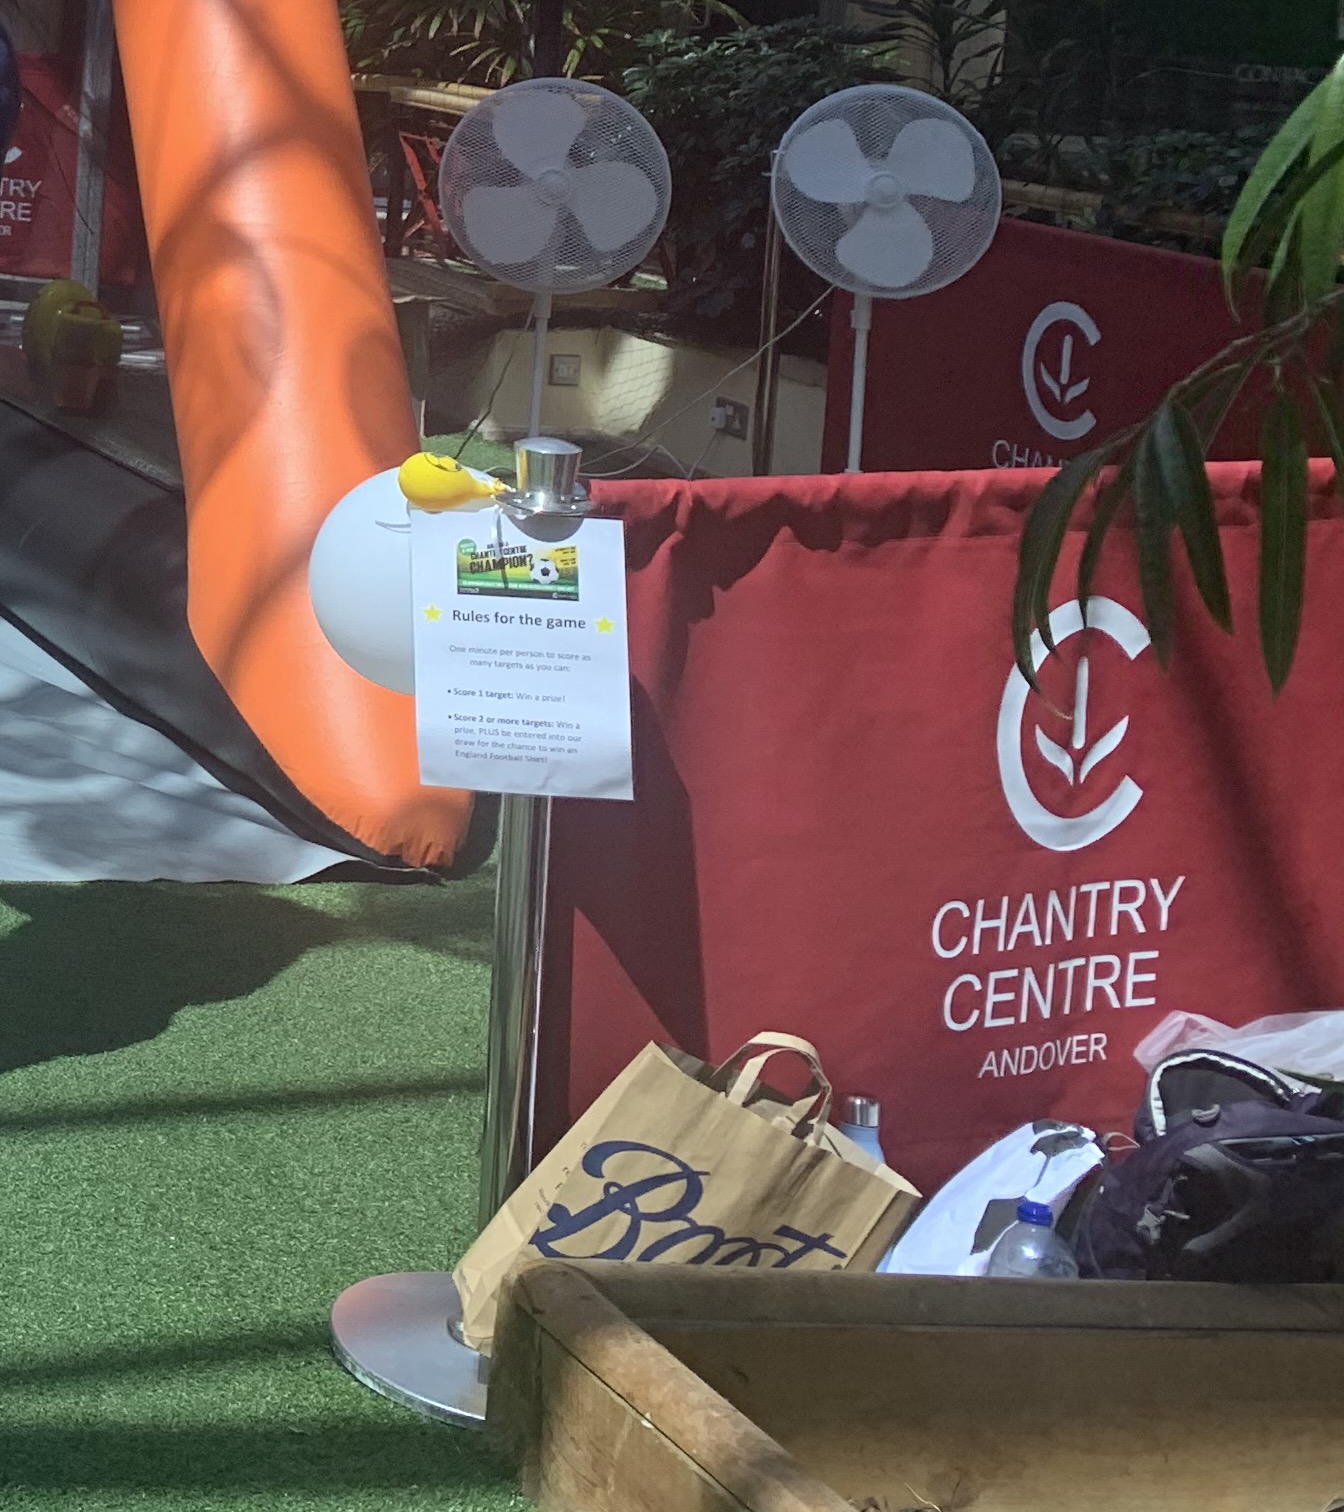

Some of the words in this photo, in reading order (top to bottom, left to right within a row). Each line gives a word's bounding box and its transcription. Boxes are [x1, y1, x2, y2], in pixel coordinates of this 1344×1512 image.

[469, 553, 534, 574] CHAMPION?
[452, 609, 490, 623] Rules
[494, 612, 515, 624] for
[519, 614, 542, 626] the
[546, 618, 586, 629] game
[449, 645, 466, 653] One
[468, 646, 497, 655] minute
[499, 648, 513, 656] per
[515, 650, 545, 658] person
[469, 659, 492, 668] many
[494, 660, 523, 670] targets
[536, 664, 551, 672] you
[453, 688, 476, 697] Score
[485, 690, 513, 700] target:
[516, 692, 533, 701] Win
[541, 694, 566, 703] prize!
[454, 713, 476, 722] Score
[478, 715, 484, 723] 2
[497, 718, 519, 726] more
[522, 719, 554, 728] targets:
[556, 721, 573, 729] Win
[478, 728, 499, 736] PLUS
[501, 728, 512, 737] be
[513, 731, 547, 739] entered
[549, 733, 565, 741] into
[454, 739, 475, 747] draw
[492, 740, 505, 749] the
[507, 741, 537, 751] chance
[538, 744, 548, 752] to
[550, 745, 565, 753] win
[455, 750, 488, 759] England
[490, 752, 523, 762] Football
[931, 875, 1186, 959] CHANTRY
[943, 950, 1160, 1032] CENTRE
[978, 1032, 1108, 1079] ANDOVER
[529, 1139, 848, 1270] Boot
